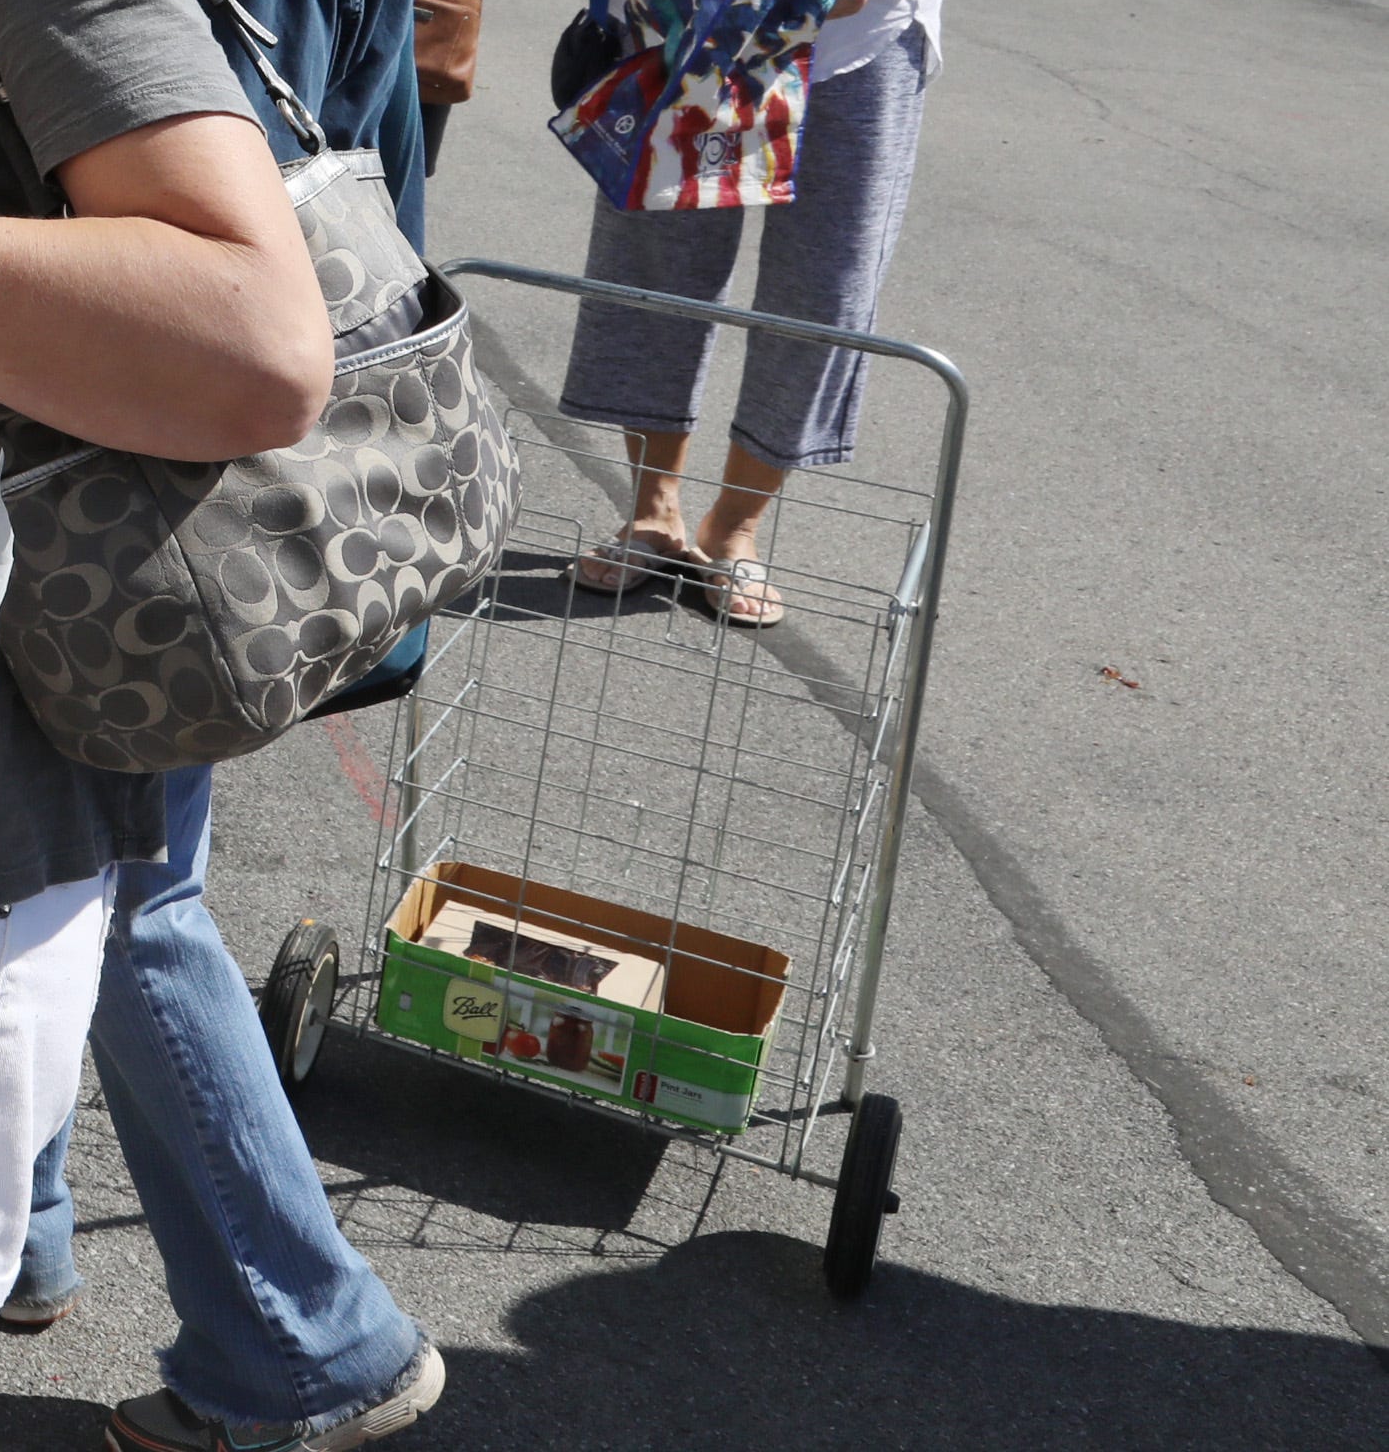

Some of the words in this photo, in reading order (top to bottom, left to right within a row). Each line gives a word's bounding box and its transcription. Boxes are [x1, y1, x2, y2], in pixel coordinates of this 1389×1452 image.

[453, 995, 499, 1020] Ball
[660, 1080, 680, 1094] Pint
[682, 1086, 703, 1101] Jars
